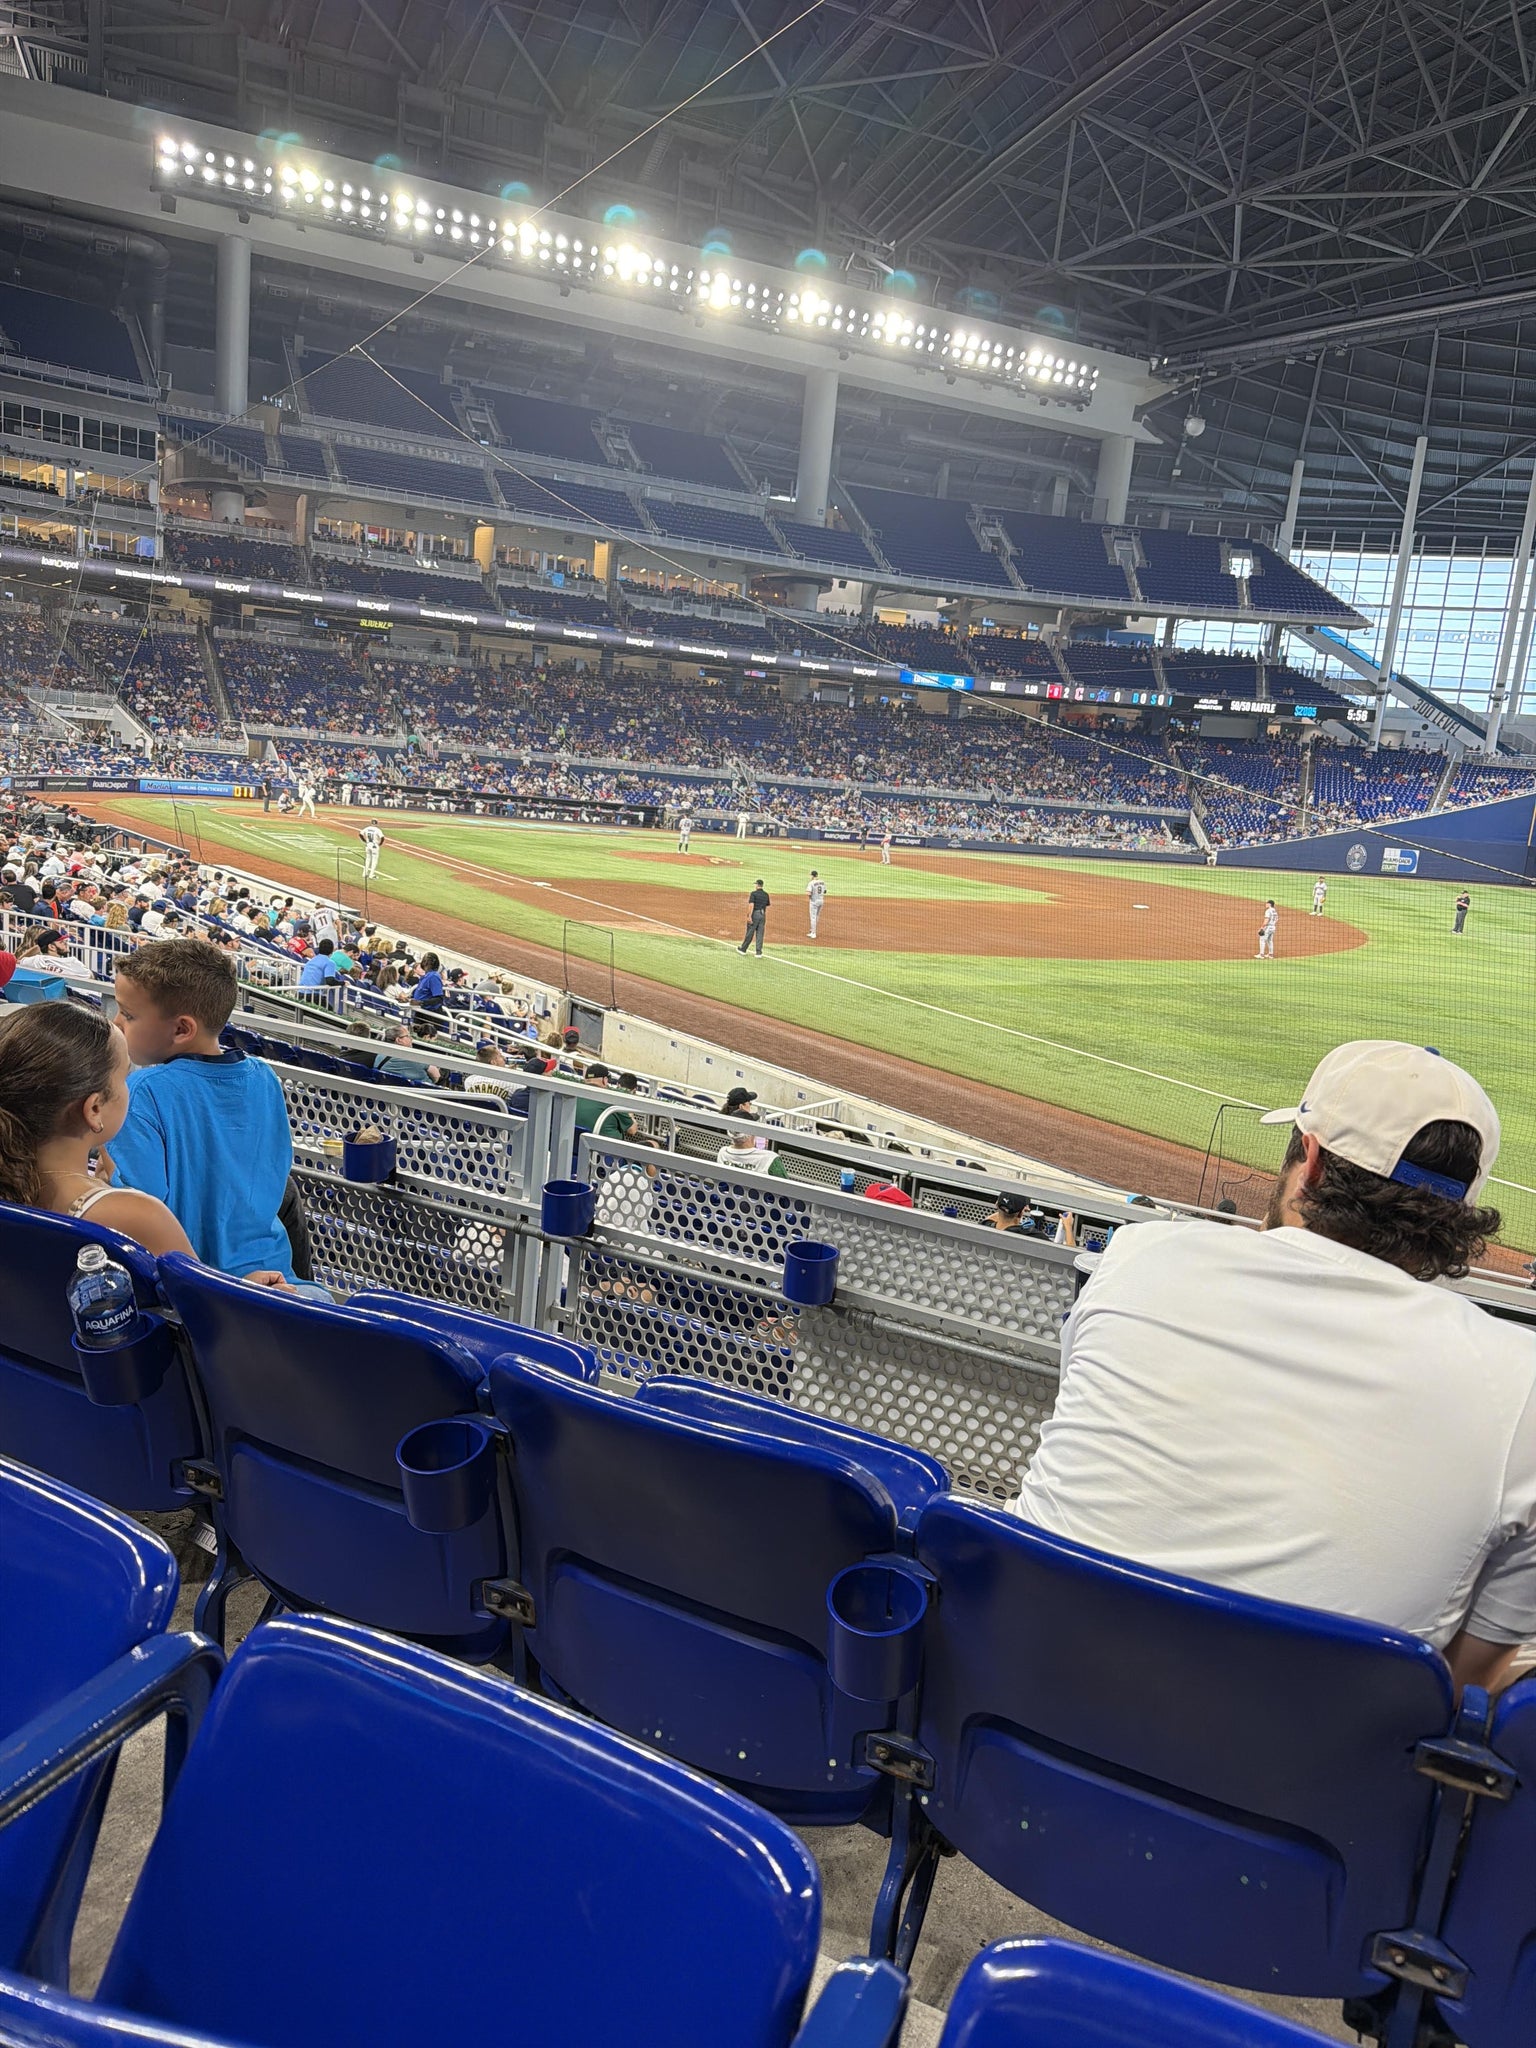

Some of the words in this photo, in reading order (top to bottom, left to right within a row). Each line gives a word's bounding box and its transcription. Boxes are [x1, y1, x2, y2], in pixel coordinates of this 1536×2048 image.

[41, 556, 79, 570] loanDepot
[151, 573, 182, 585] Everything
[215, 581, 249, 593] loanDepot
[356, 599, 389, 611] loanDepot
[505, 620, 536, 631] loanDepot
[1251, 702, 1276, 714] RAFFLE
[92, 780, 128, 790] loanDepot
[145, 782, 173, 790] Marlins
[319, 914, 329, 927] 11
[85, 1304, 135, 1330] AQUAFINA
